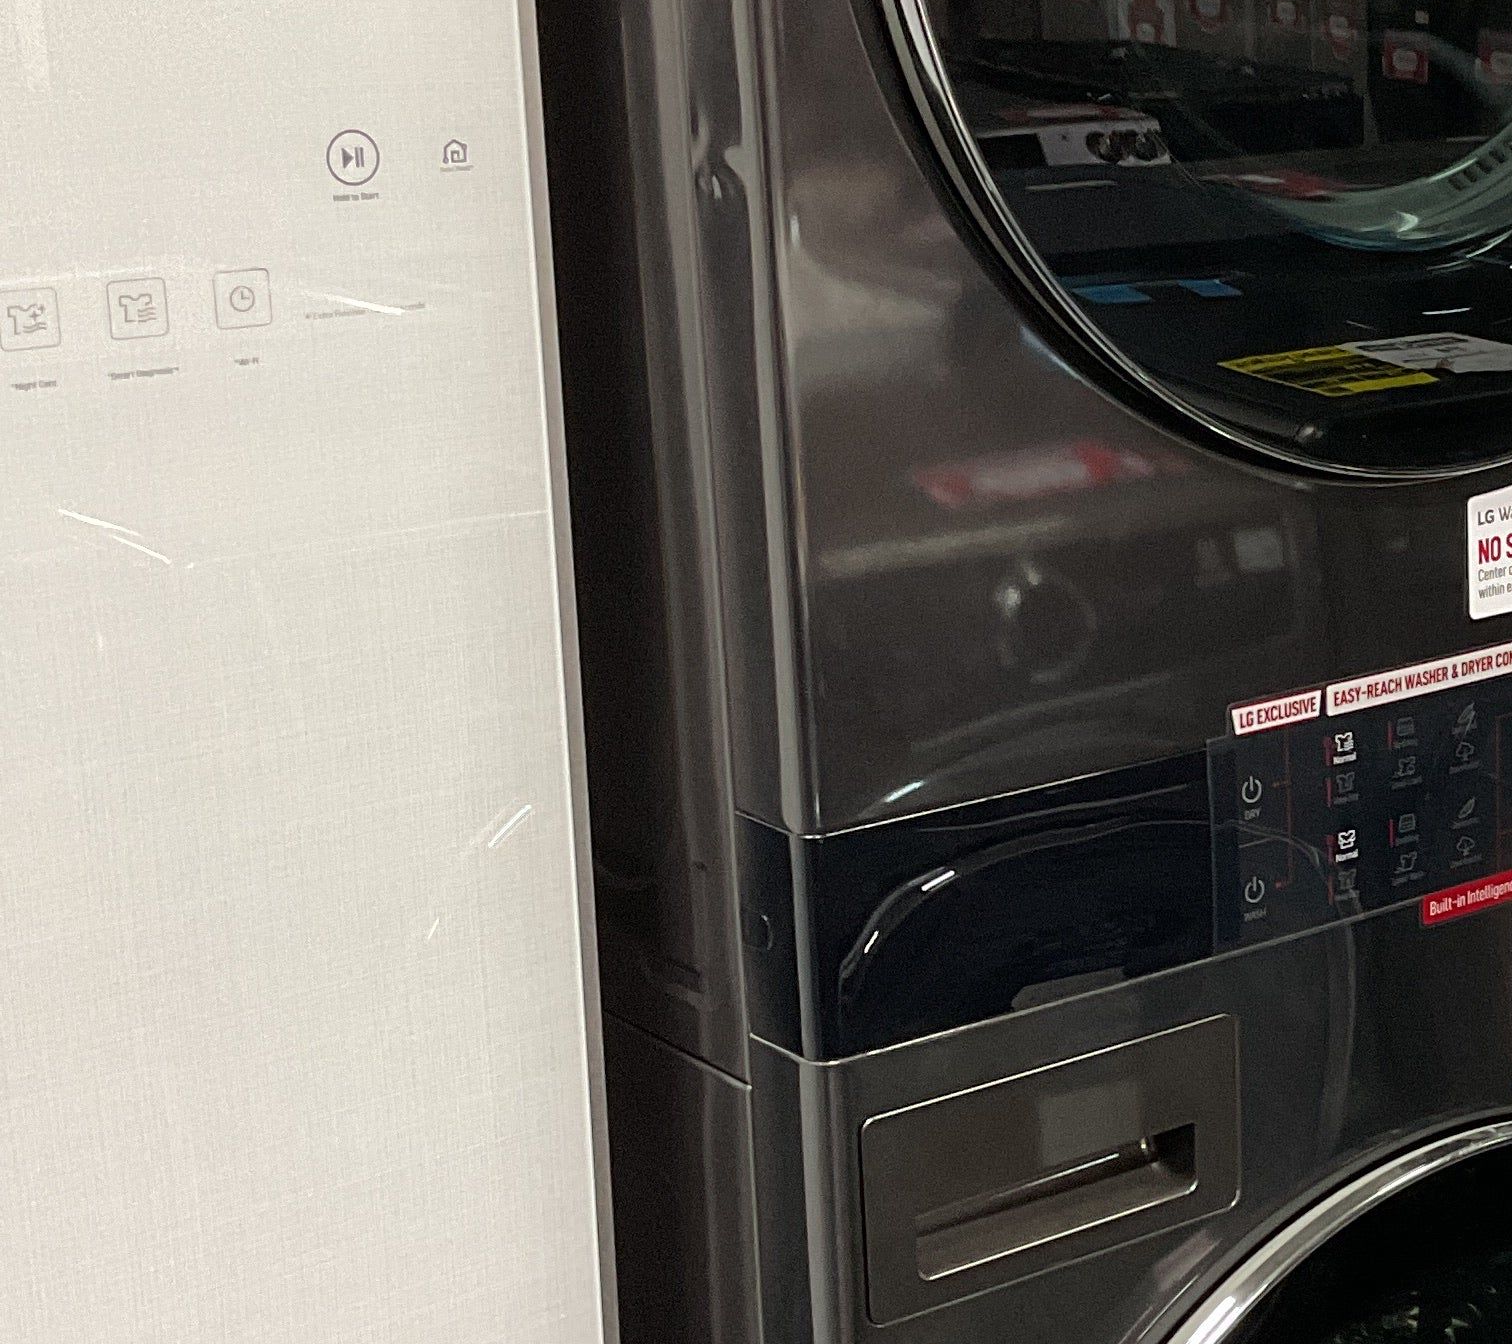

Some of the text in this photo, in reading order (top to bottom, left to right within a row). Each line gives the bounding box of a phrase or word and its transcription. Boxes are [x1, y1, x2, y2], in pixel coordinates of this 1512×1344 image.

[1477, 509, 1495, 525] LG
[1478, 536, 1502, 564] NO
[1478, 566, 1507, 582] Center
[1478, 582, 1505, 599] within
[1333, 676, 1403, 707] EASY-REACH
[1405, 664, 1449, 691] WASHER
[1451, 663, 1459, 679] &
[1461, 654, 1494, 676] DRYER
[1239, 696, 1317, 729] LG EXCLUSIVE
[1429, 892, 1466, 916] Built-in
